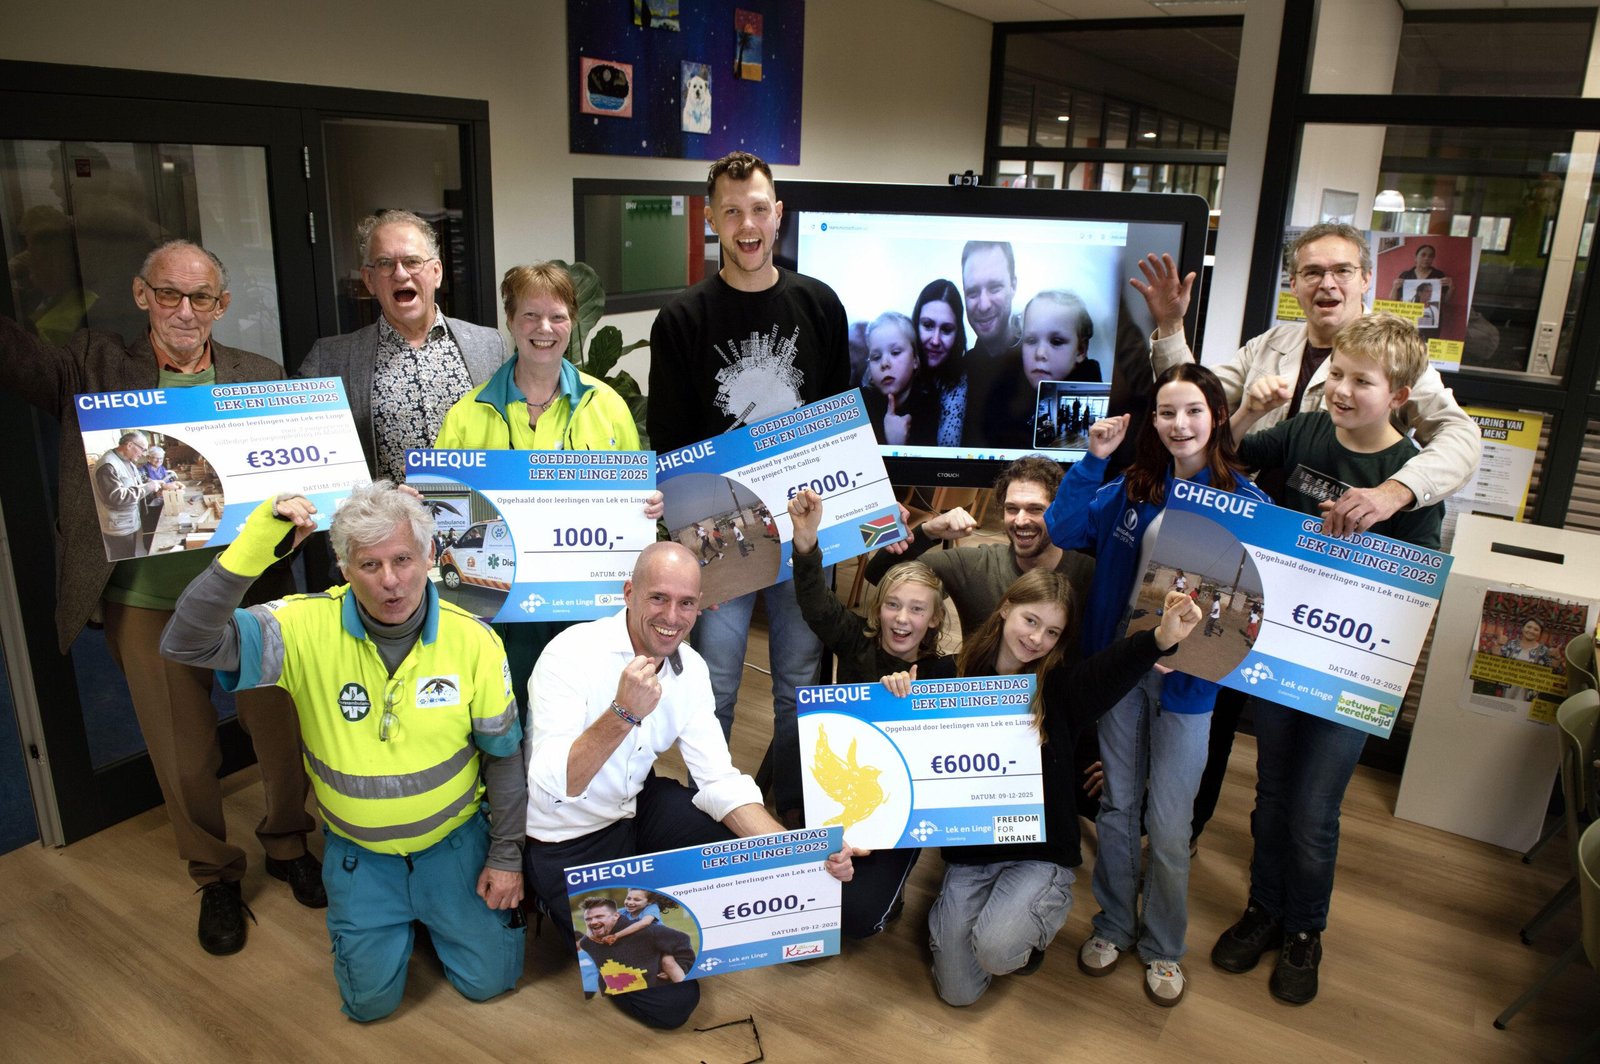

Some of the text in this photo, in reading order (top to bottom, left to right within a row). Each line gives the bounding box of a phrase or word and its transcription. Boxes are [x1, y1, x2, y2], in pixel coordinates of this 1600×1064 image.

[211, 379, 337, 398] GOEDEDOELENDAG
[78, 389, 167, 411] CHEQUE
[215, 391, 339, 413] LEK EN LINGE 2025
[184, 421, 226, 433] Opgehaald
[227, 420, 244, 429] door
[285, 416, 299, 425] van
[299, 415, 313, 423] Lek
[313, 414, 324, 422] en
[750, 394, 856, 438] GOEDEDOELENDAG
[1506, 420, 1523, 430] VAN
[754, 408, 860, 452] LEK EN LINGE 2025
[1483, 429, 1507, 440] MENS
[246, 445, 337, 468] €3300,-
[408, 451, 487, 468] CHEQUE
[529, 453, 649, 466] GOEDEDOELENDAG
[737, 459, 773, 477] Fundraised
[773, 457, 782, 465] by
[782, 449, 810, 462] students
[818, 442, 831, 450] Lek
[831, 438, 840, 446] en
[839, 432, 858, 443] Linge
[529, 469, 649, 481] LEK EN LINGE 2025
[761, 469, 784, 482] project
[783, 463, 797, 472] The
[496, 496, 536, 506] Opgehaald
[536, 496, 553, 504] door
[553, 496, 590, 506] leerlingen
[605, 496, 619, 504] Lek
[1173, 481, 1258, 519] CHEQUE
[835, 501, 879, 521] December 2025
[552, 527, 625, 550] 1000,-
[1301, 519, 1443, 569] GODOELENDAG
[1296, 535, 1438, 586] LEK EN LINGE 2025
[1255, 550, 1432, 609] Opgehaald door leerlingen van Lek en Linge:
[552, 598, 565, 607] Lek
[575, 598, 594, 609] Linge
[1291, 603, 1391, 651] €6500,-
[911, 679, 1029, 695] GOEDEDOELENDAG
[1328, 663, 1402, 692] DATUM: 09-12-2025
[798, 686, 871, 704] CHEQUE
[1280, 678, 1334, 702] Lek en Linge
[912, 693, 1030, 711] LEK EN LINGE 2025
[1338, 695, 1377, 714] betuwe
[1337, 705, 1391, 727] wereldwijd
[884, 725, 922, 733] Opgehaald
[939, 722, 975, 730] leerlingen
[930, 752, 1017, 775] €6000,-
[998, 791, 1034, 800] 09-12-2025
[996, 814, 1039, 824] FREEDOM
[945, 823, 992, 835] Lek en Linge
[996, 825, 1015, 833] FOR
[998, 834, 1037, 843] UKRAINE
[701, 829, 828, 857] GOEDEDOELENDAG
[702, 841, 829, 870] LEK EN LINGE 2025
[566, 858, 654, 886] CHEQUE
[672, 884, 714, 897] Opgehaald
[715, 880, 734, 889] door
[735, 873, 774, 886] leerlingen
[722, 894, 816, 920] €6000,-
[800, 921, 838, 932] 09-12-2025
[750, 951, 769, 960] Linge
[785, 945, 822, 958] Kind
